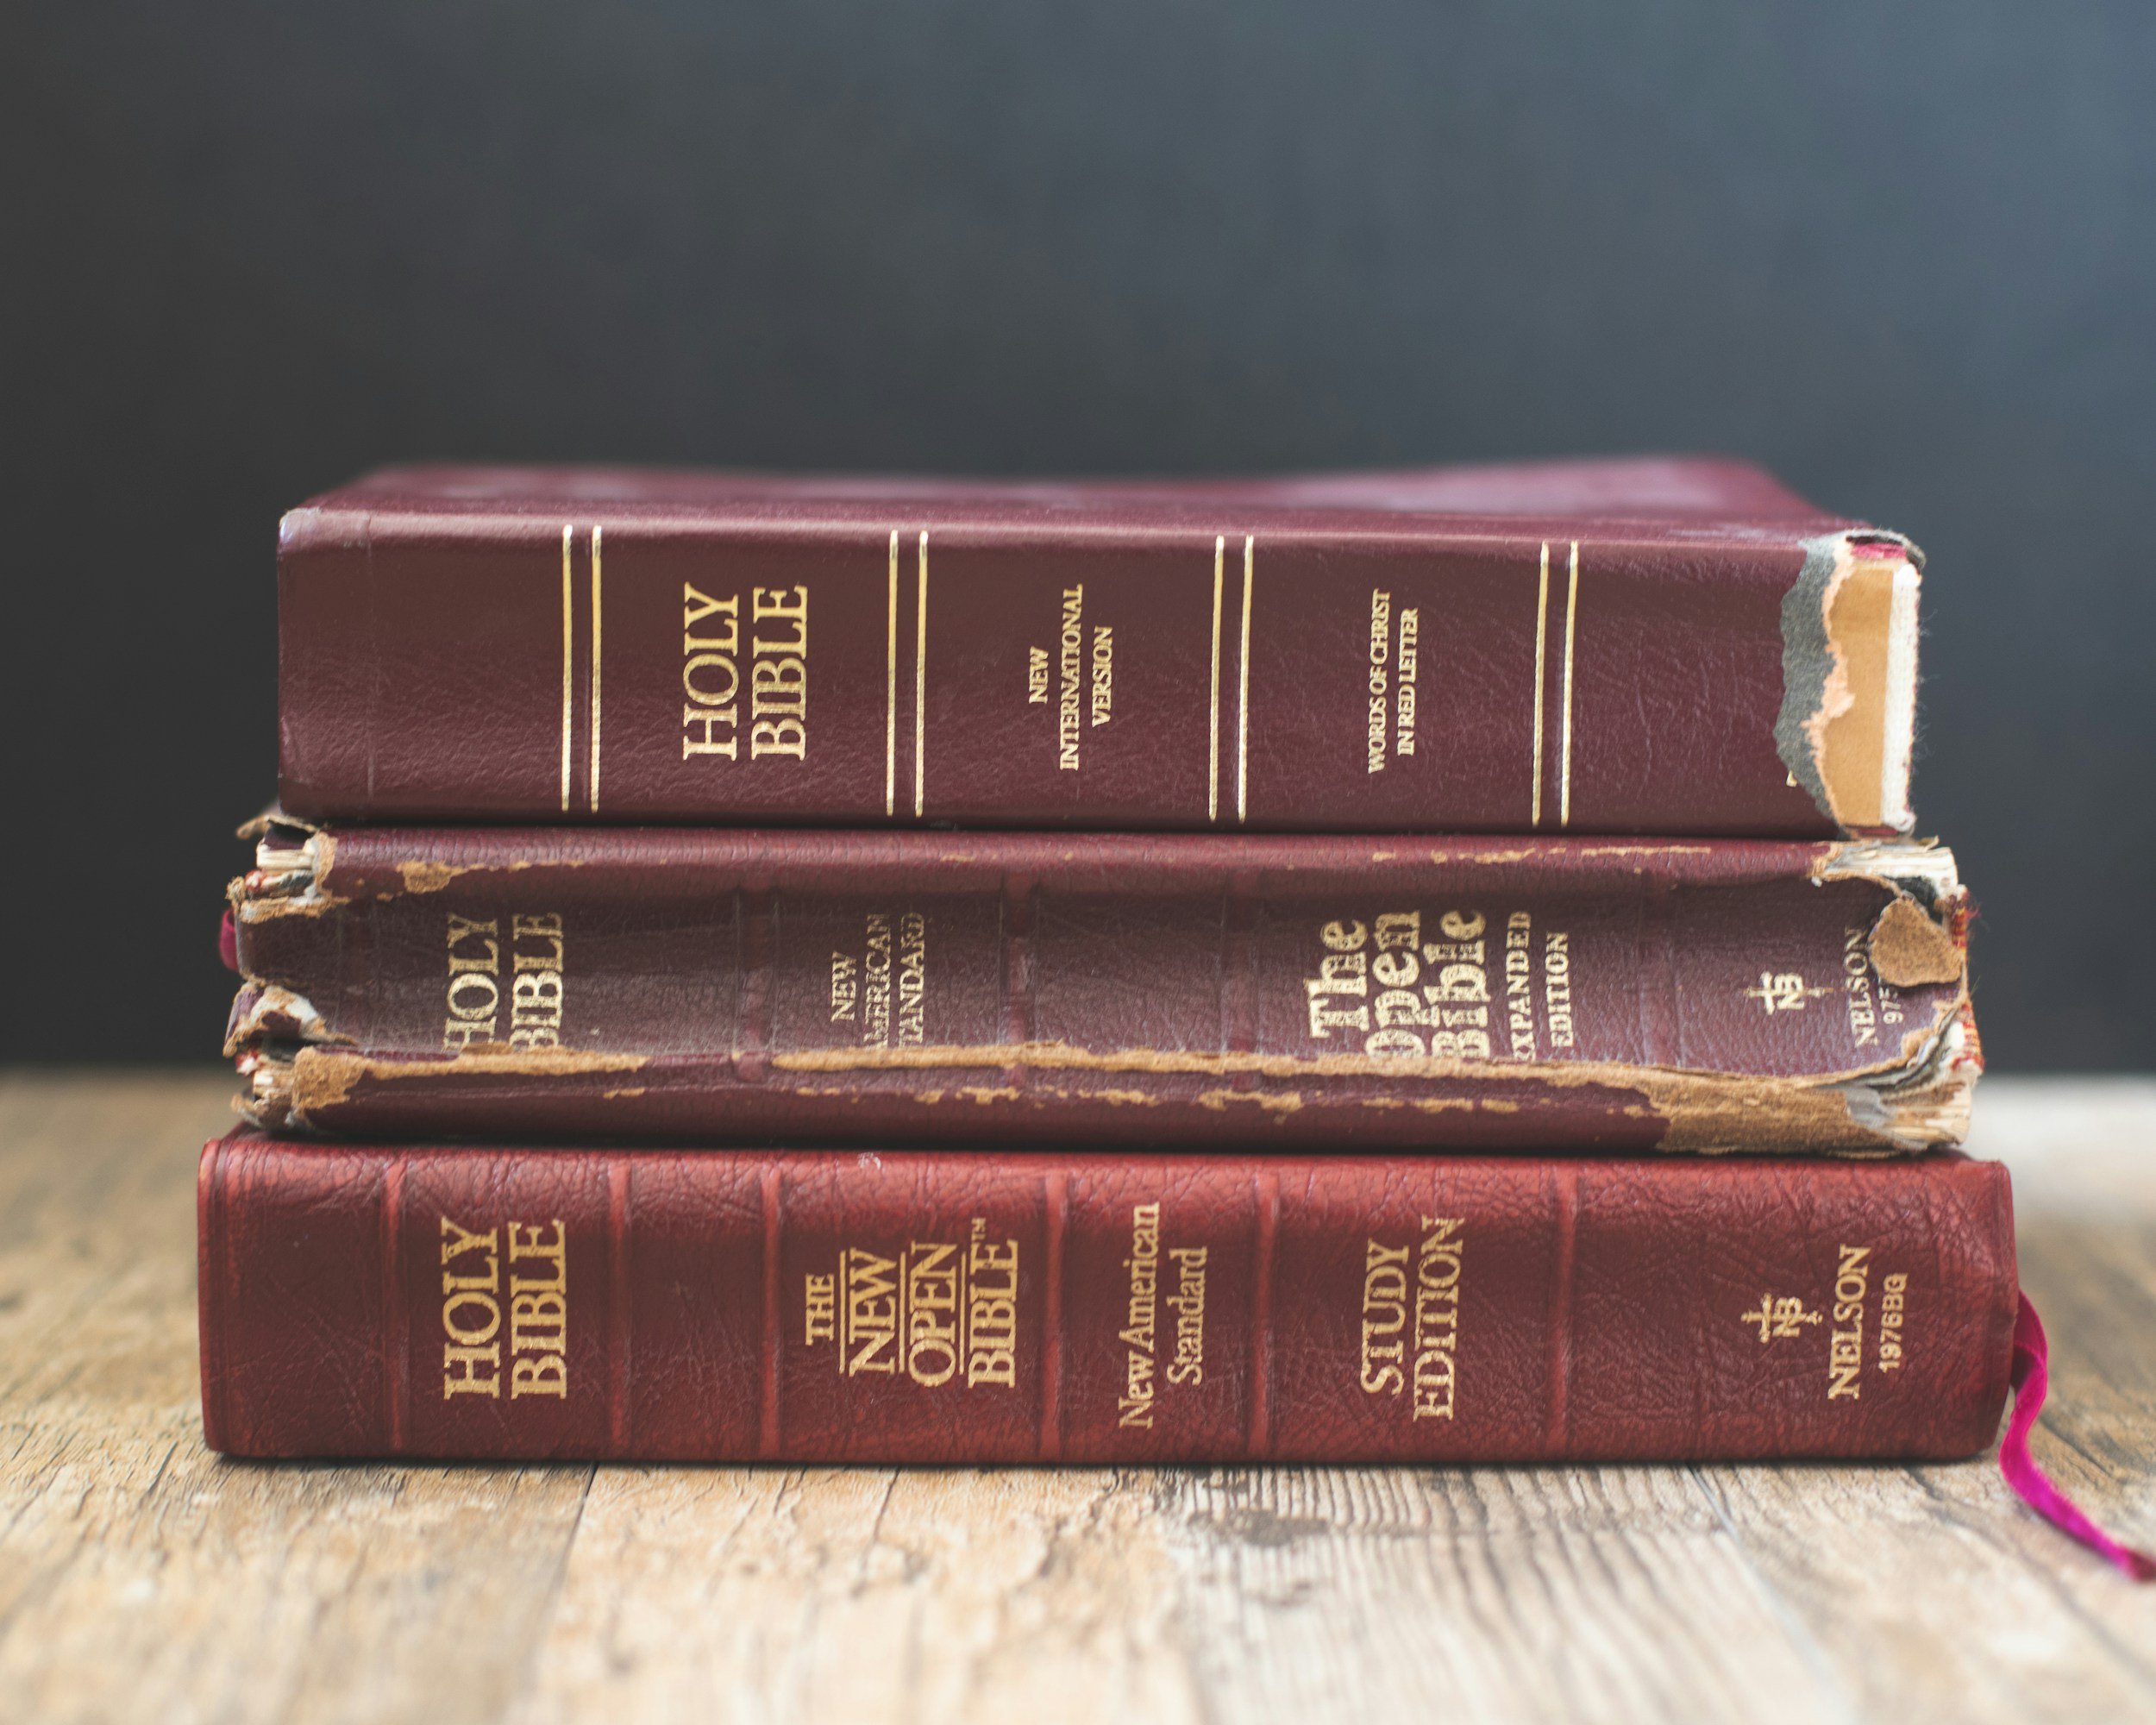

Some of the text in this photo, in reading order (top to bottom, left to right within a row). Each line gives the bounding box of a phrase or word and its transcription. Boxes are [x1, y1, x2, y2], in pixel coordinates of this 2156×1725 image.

[682, 580, 740, 762] HOLY
[750, 583, 809, 762] BIBLE
[1029, 645, 1050, 705] NEW
[1059, 582, 1083, 771] INTERNATIONAL
[1091, 624, 1113, 728] VERSION
[1368, 587, 1391, 775] WORDS OF CHRIST
[1396, 607, 1419, 756] IN RED LETTER
[442, 912, 499, 1052] HOLY
[509, 912, 564, 1047] BIBLE
[830, 950, 857, 1023] NEW
[898, 912, 925, 1048] TANDARD
[1303, 919, 1369, 1039] The
[1364, 910, 1440, 1058] Open
[1423, 909, 1491, 1058] Bible
[1545, 931, 1574, 1047] EDITION
[1843, 925, 1878, 1048] NELSON
[441, 1214, 502, 1400] HOLY
[507, 1219, 567, 1400] BIBLE
[805, 1273, 835, 1346] THE
[849, 1247, 898, 1377] NEW
[908, 1239, 958, 1387] OPEN
[1119, 1201, 1161, 1430] New American
[1166, 1246, 1208, 1386] Standard
[1360, 1236, 1410, 1396] STUDY
[1412, 1214, 1466, 1422] EDITION
[1827, 1243, 1872, 1400] NELSON
